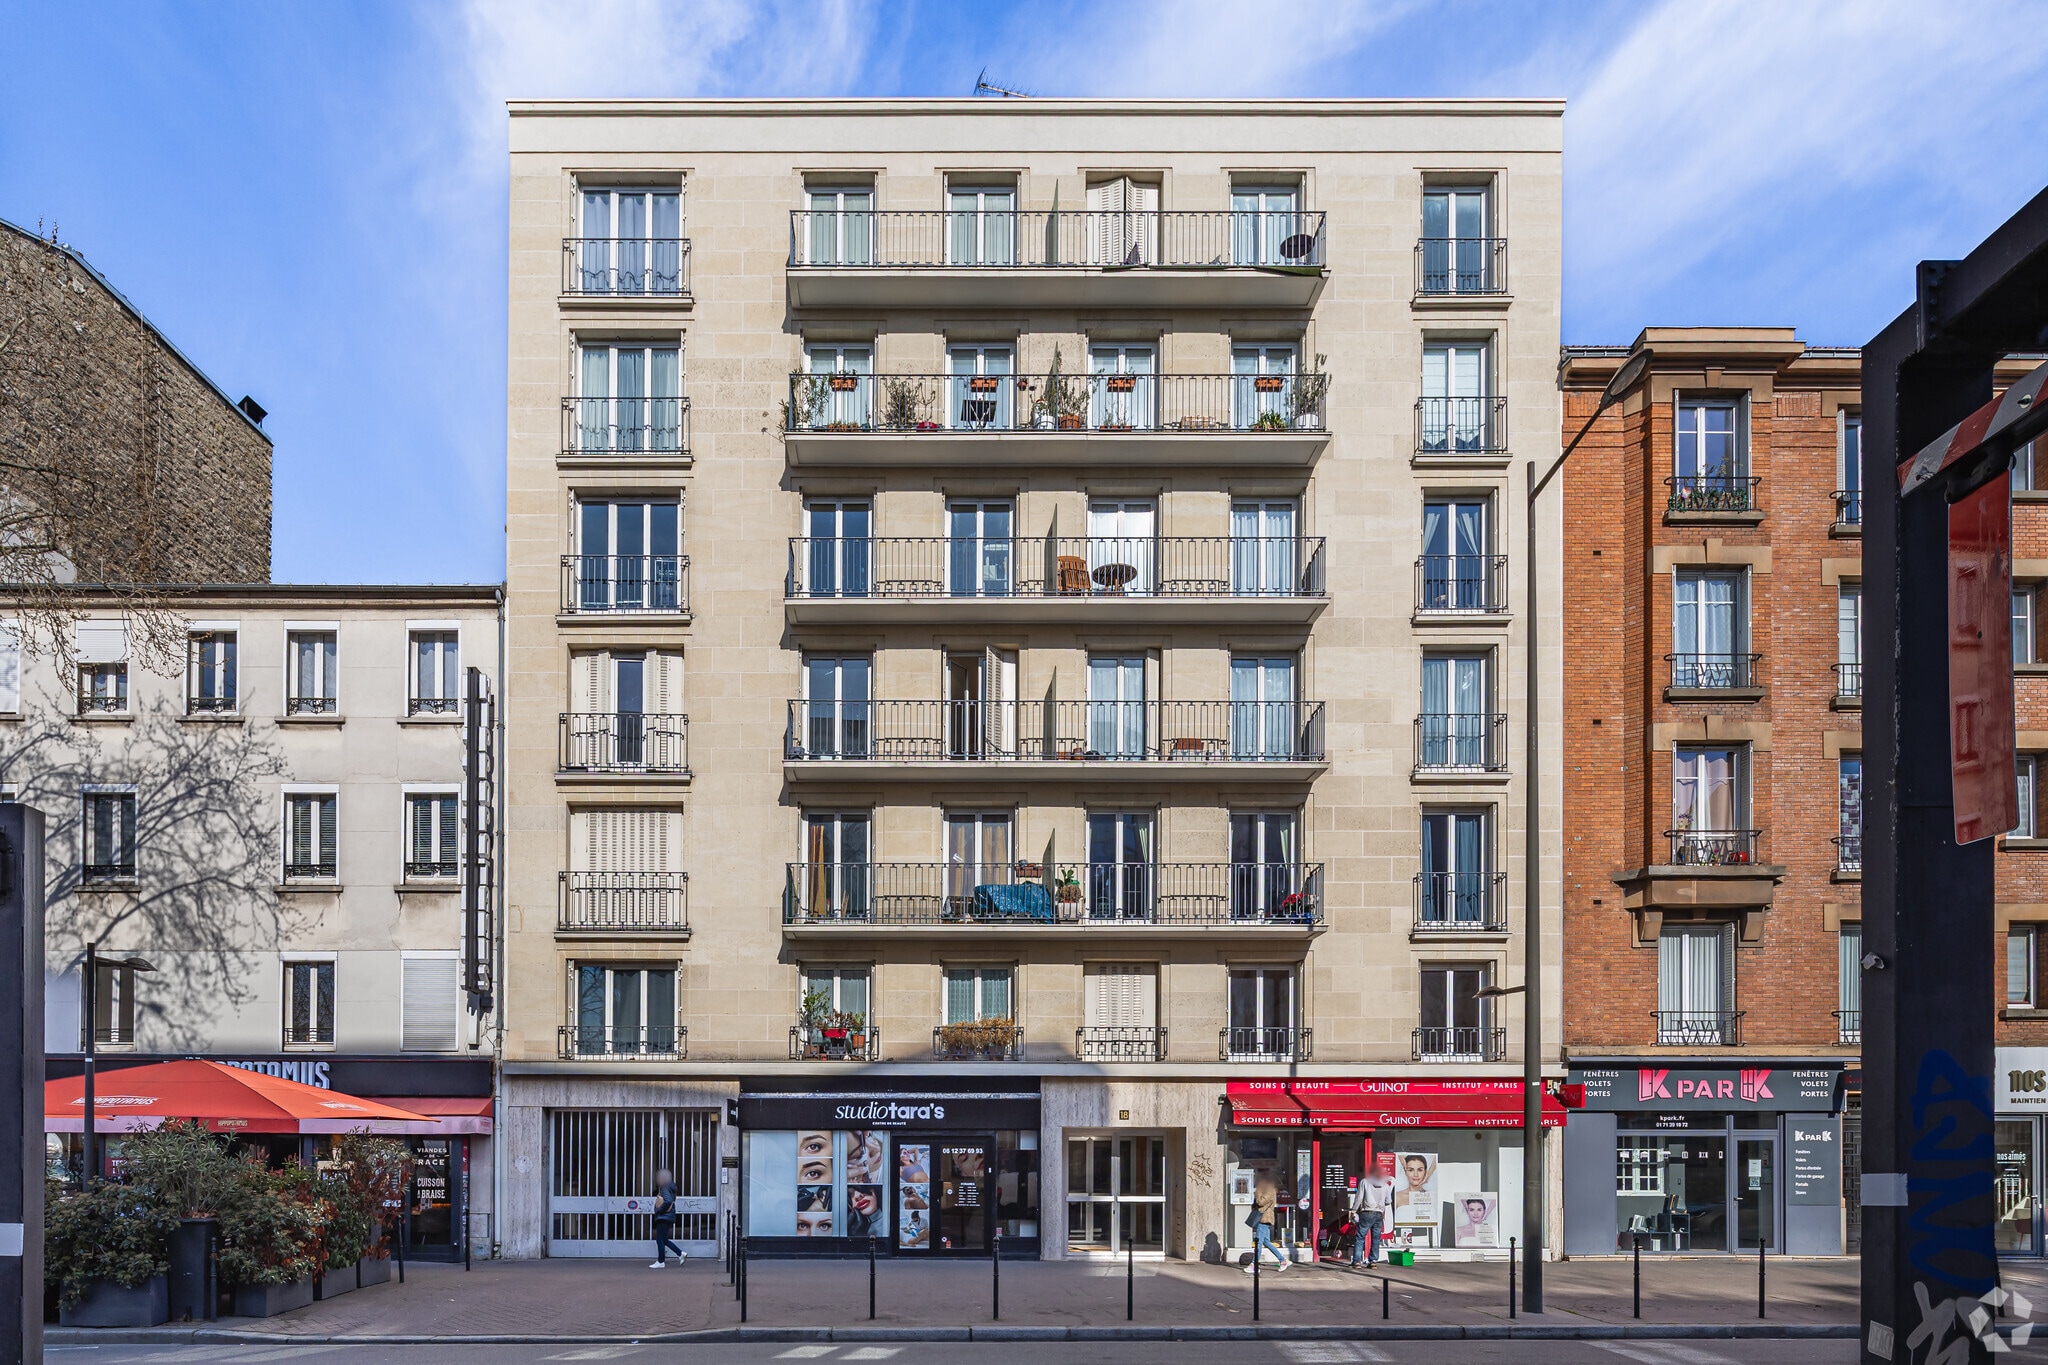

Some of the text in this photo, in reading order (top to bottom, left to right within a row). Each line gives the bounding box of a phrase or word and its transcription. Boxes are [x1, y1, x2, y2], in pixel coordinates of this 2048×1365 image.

[1583, 1069, 1619, 1078] FENÊTRES
[1792, 1069, 1829, 1078] FENÊTRES
[1359, 1079, 1410, 1093] GUINOT
[1120, 1110, 1128, 1119] 18
[1379, 1113, 1421, 1125] GUINOT
[1241, 1116, 1271, 1124] SOINS
[417, 1158, 445, 1166] RACE
[417, 1177, 445, 1187] CUISSON
[421, 1189, 445, 1199] BRAISE
